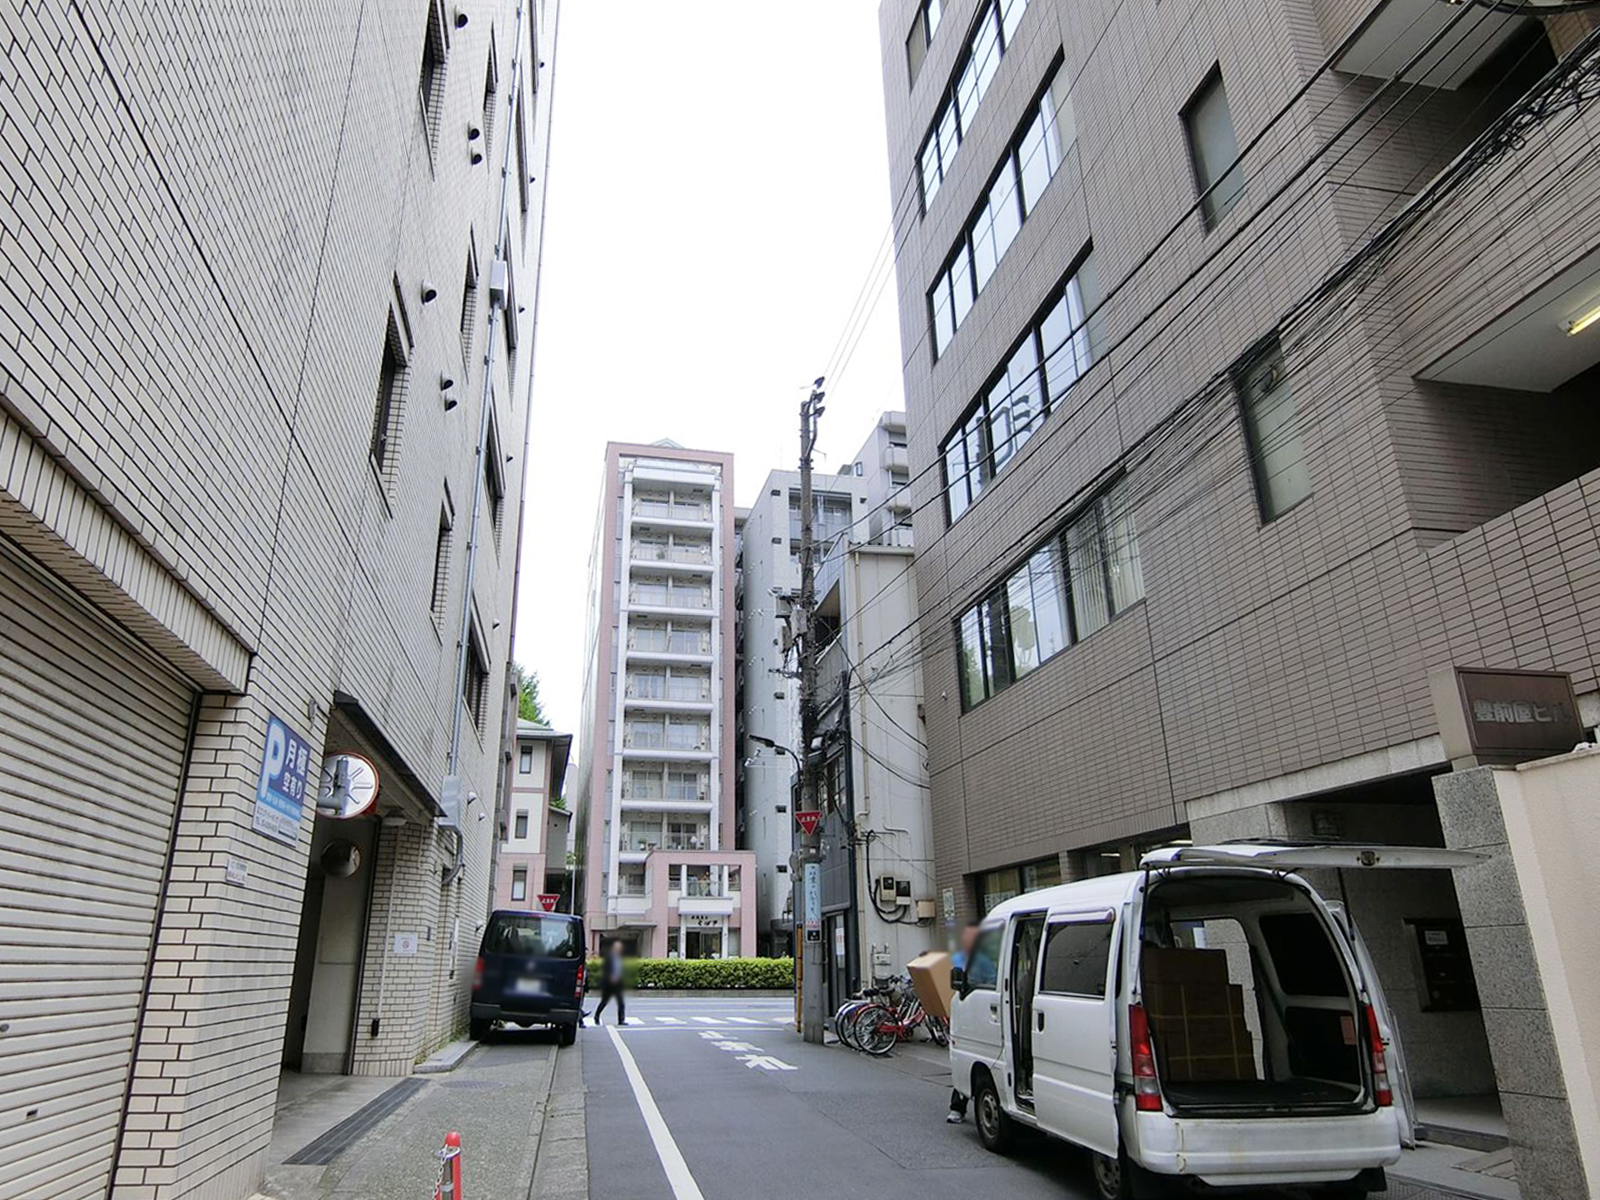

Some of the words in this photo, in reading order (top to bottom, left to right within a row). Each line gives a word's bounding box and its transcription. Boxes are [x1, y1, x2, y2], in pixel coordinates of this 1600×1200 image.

[1474, 700, 1573, 723] 豊前屋ビル
[260, 723, 286, 798] P
[285, 738, 308, 776] 月極
[282, 772, 303, 799] 空有り
